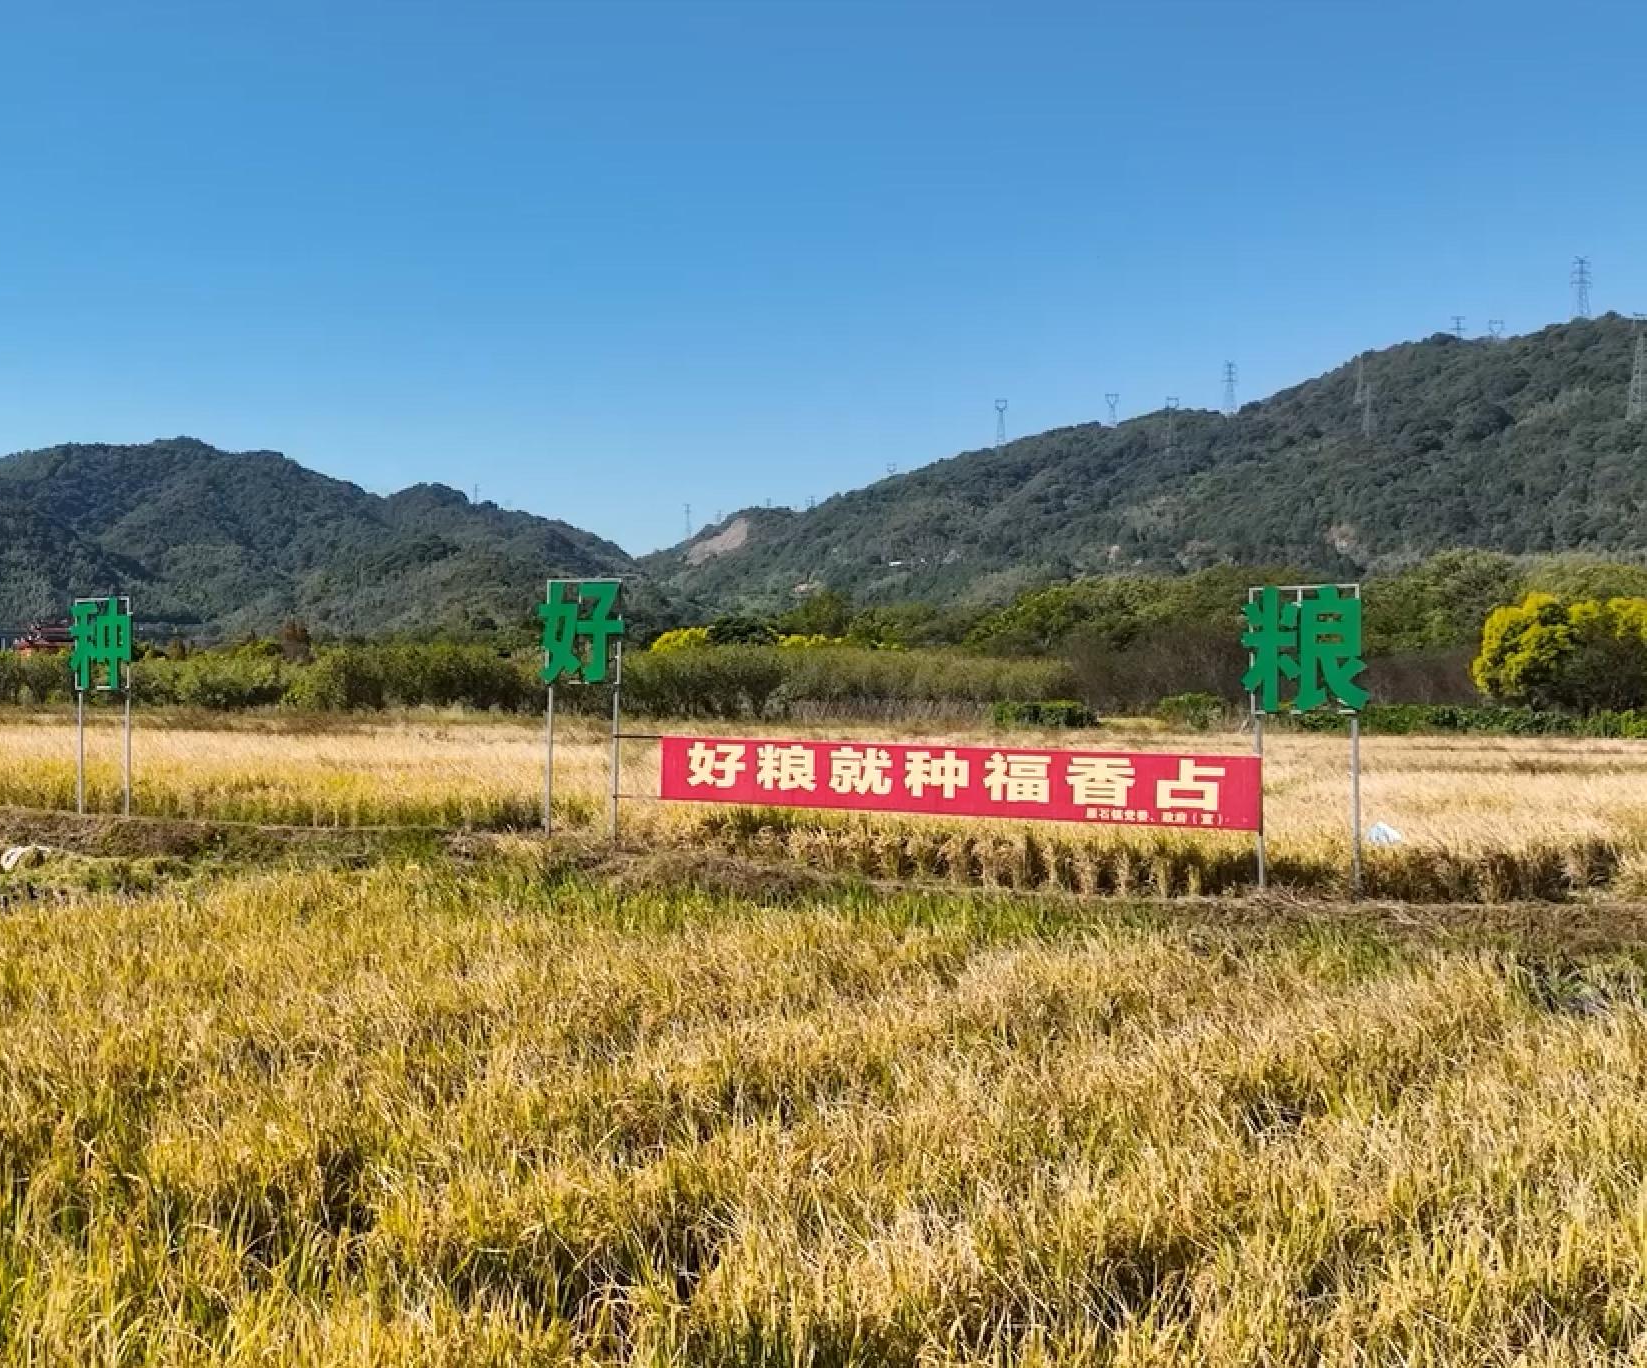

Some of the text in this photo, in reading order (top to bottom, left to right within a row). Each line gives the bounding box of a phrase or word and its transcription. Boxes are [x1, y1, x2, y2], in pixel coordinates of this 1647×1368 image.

[69, 597, 131, 690] 种
[538, 580, 625, 683] 好
[1241, 584, 1370, 711] 粮
[687, 741, 1226, 811] 好粮就种福香占
